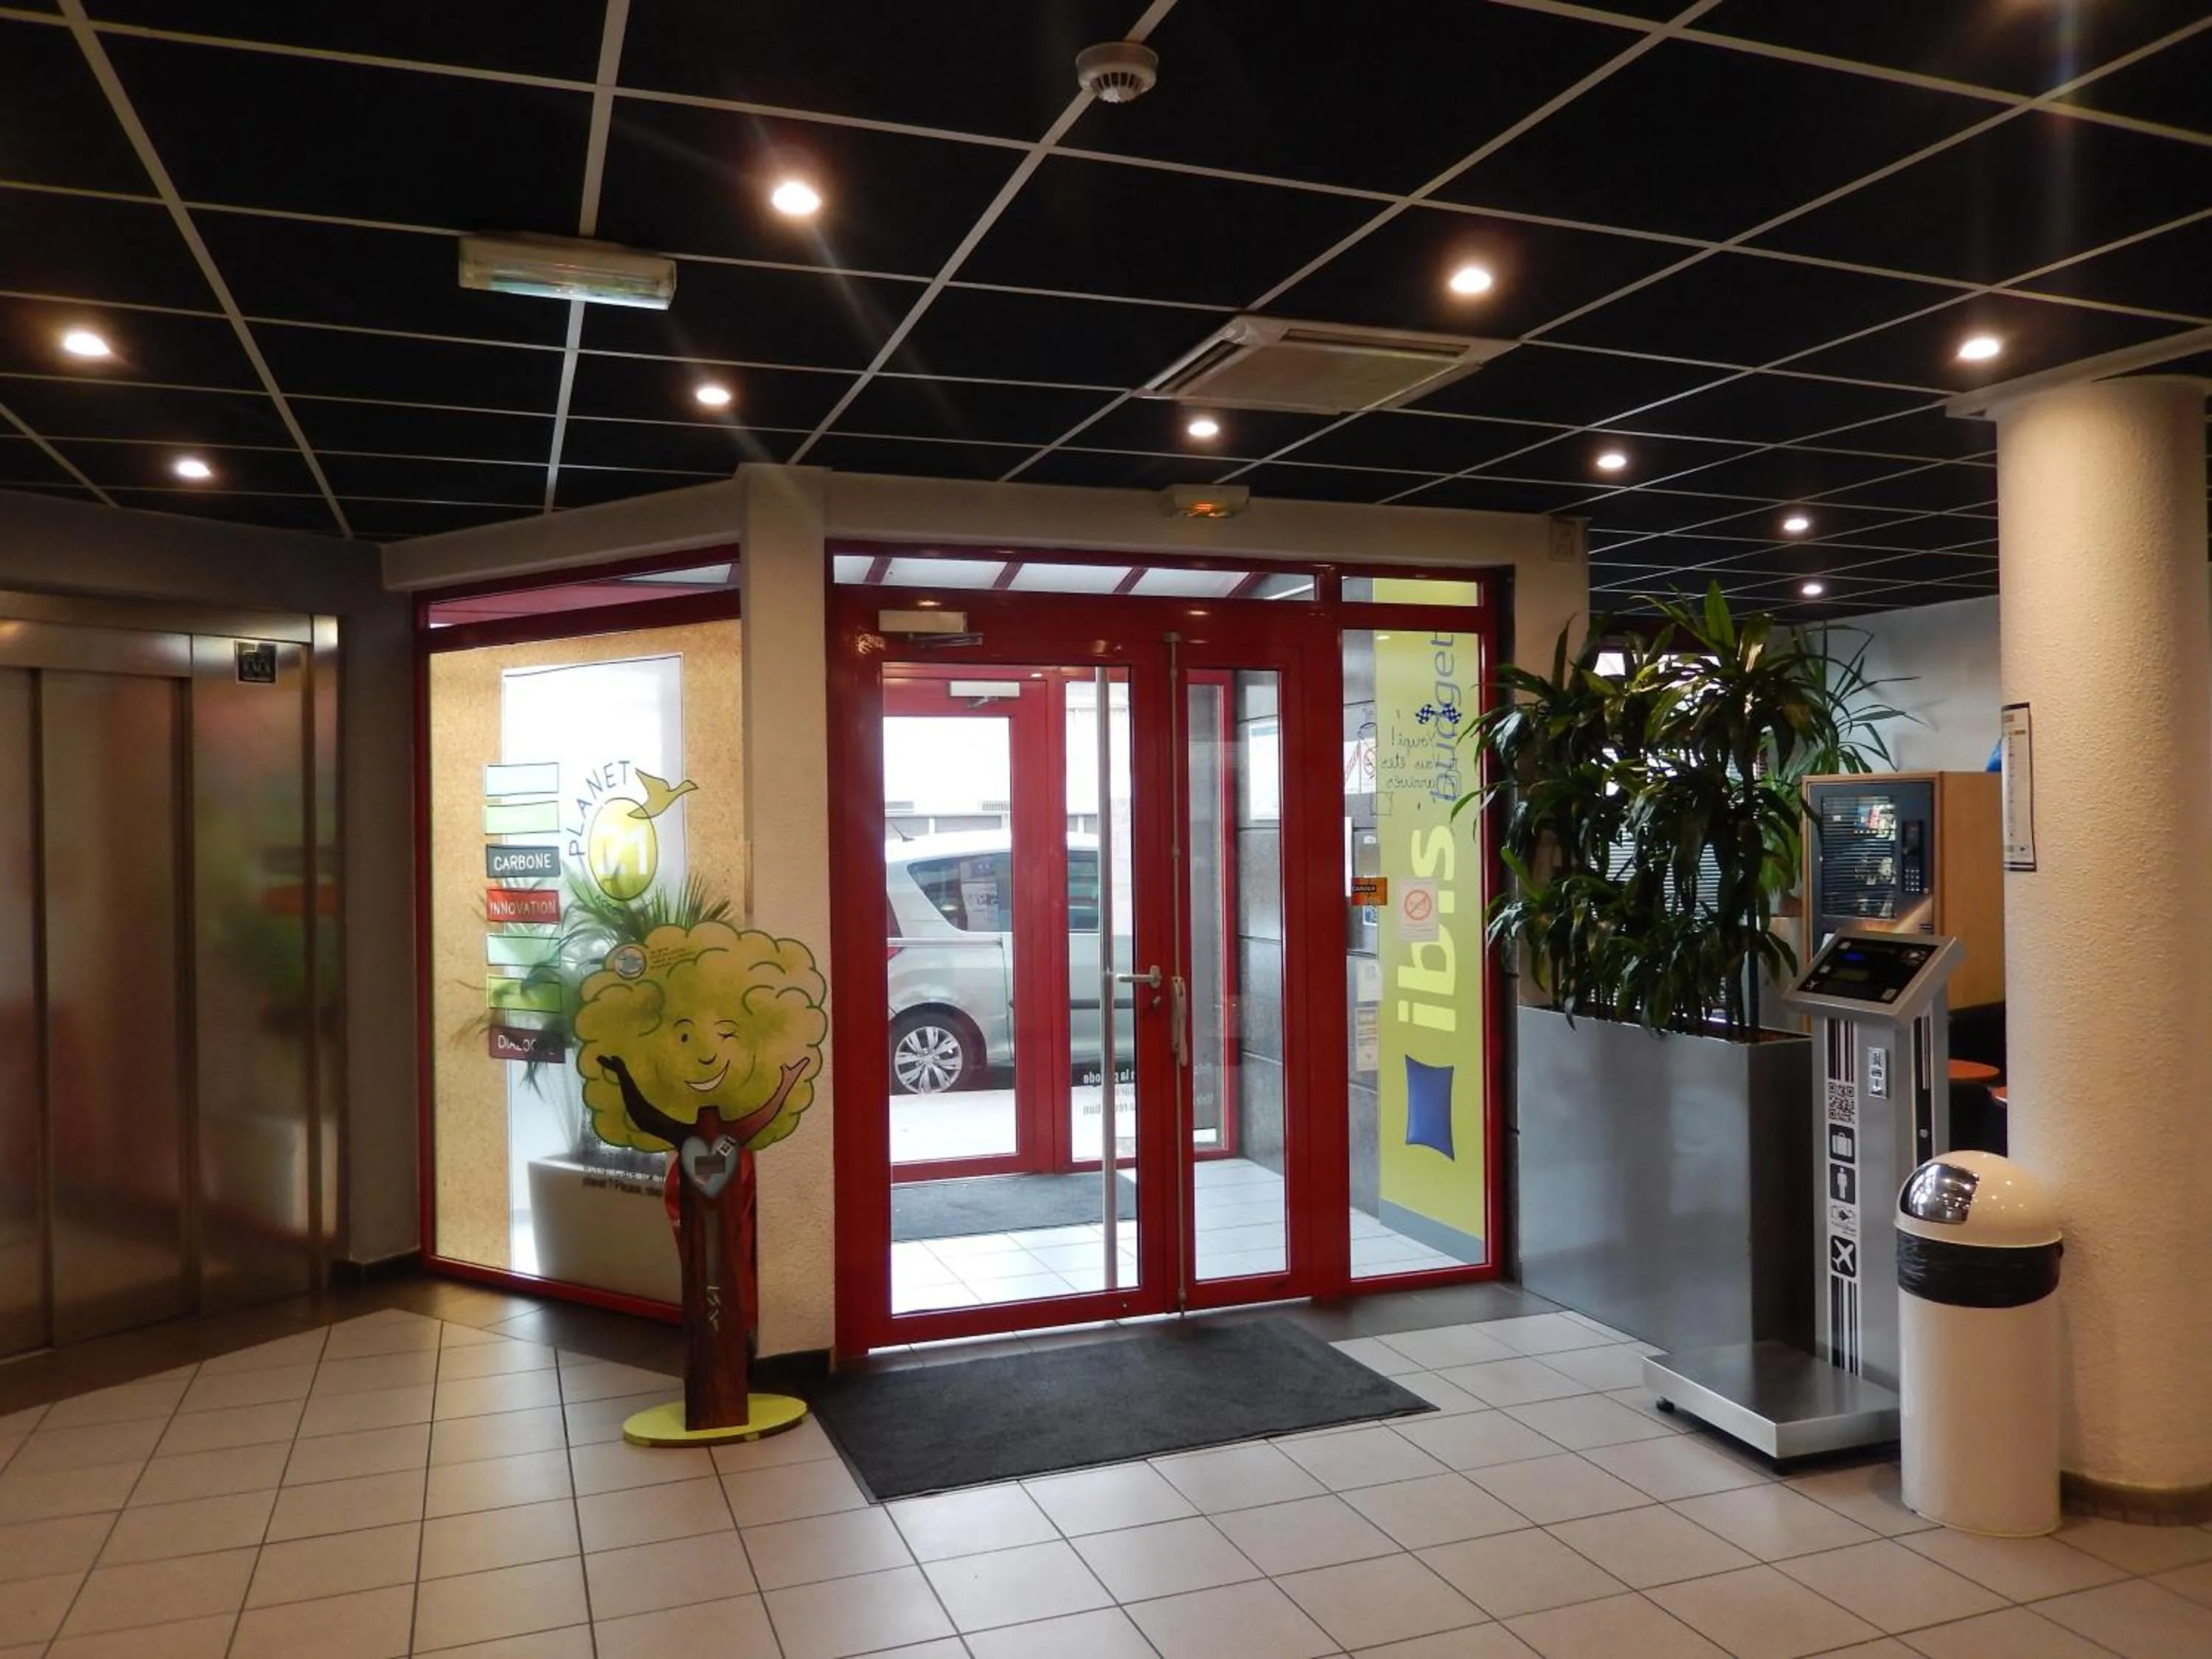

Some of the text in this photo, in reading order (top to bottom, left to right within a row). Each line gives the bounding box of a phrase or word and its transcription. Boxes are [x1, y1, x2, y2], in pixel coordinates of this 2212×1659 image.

[566, 760, 631, 857] PLANET
[493, 853, 552, 871] CARBONE
[490, 899, 555, 915] INNOVATION
